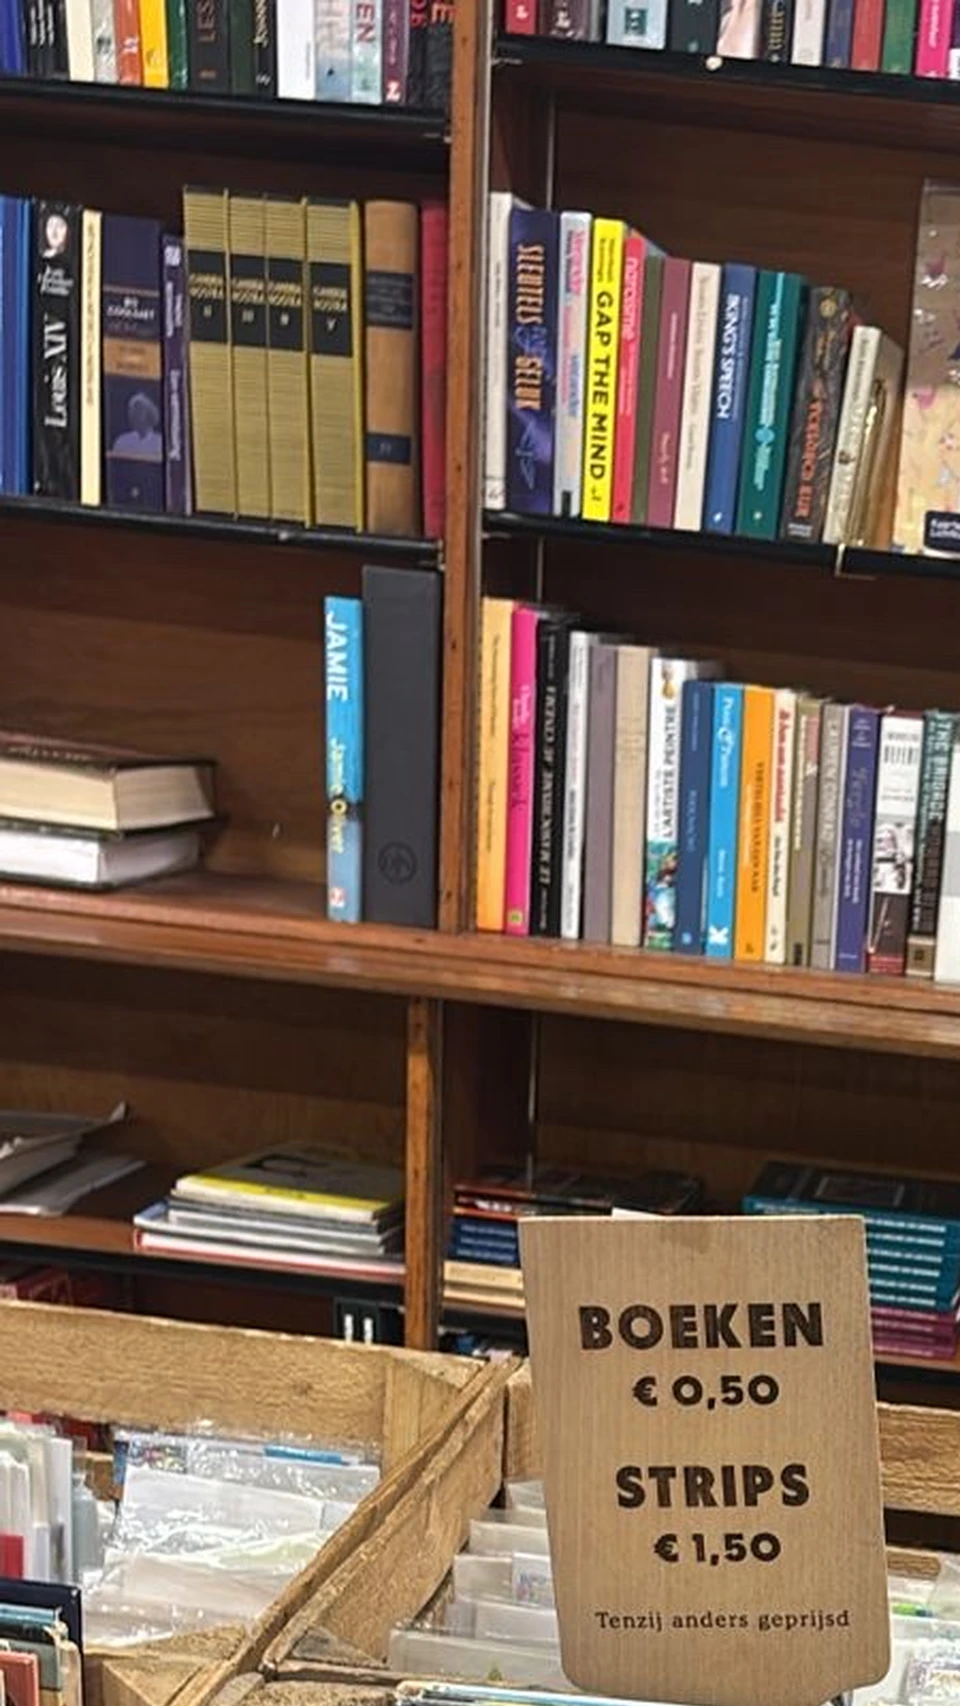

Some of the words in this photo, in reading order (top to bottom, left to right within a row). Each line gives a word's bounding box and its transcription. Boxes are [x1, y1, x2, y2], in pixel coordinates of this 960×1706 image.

[517, 243, 545, 325] SLEUTELS
[595, 291, 614, 346] GAP
[44, 365, 67, 428] Louis
[593, 356, 612, 407] THE
[589, 414, 609, 480] MIND
[325, 610, 349, 704] JAMIE
[579, 1302, 823, 1350] BOEKEN
[632, 1376, 658, 1406] €
[672, 1375, 780, 1410] 0,50
[615, 1464, 810, 1509] STRIPS
[653, 1534, 679, 1563] €
[692, 1532, 781, 1566] 1,50
[595, 1611, 665, 1633] Tenzij
[672, 1610, 749, 1630] anders
[758, 1608, 850, 1632] geprijsd
